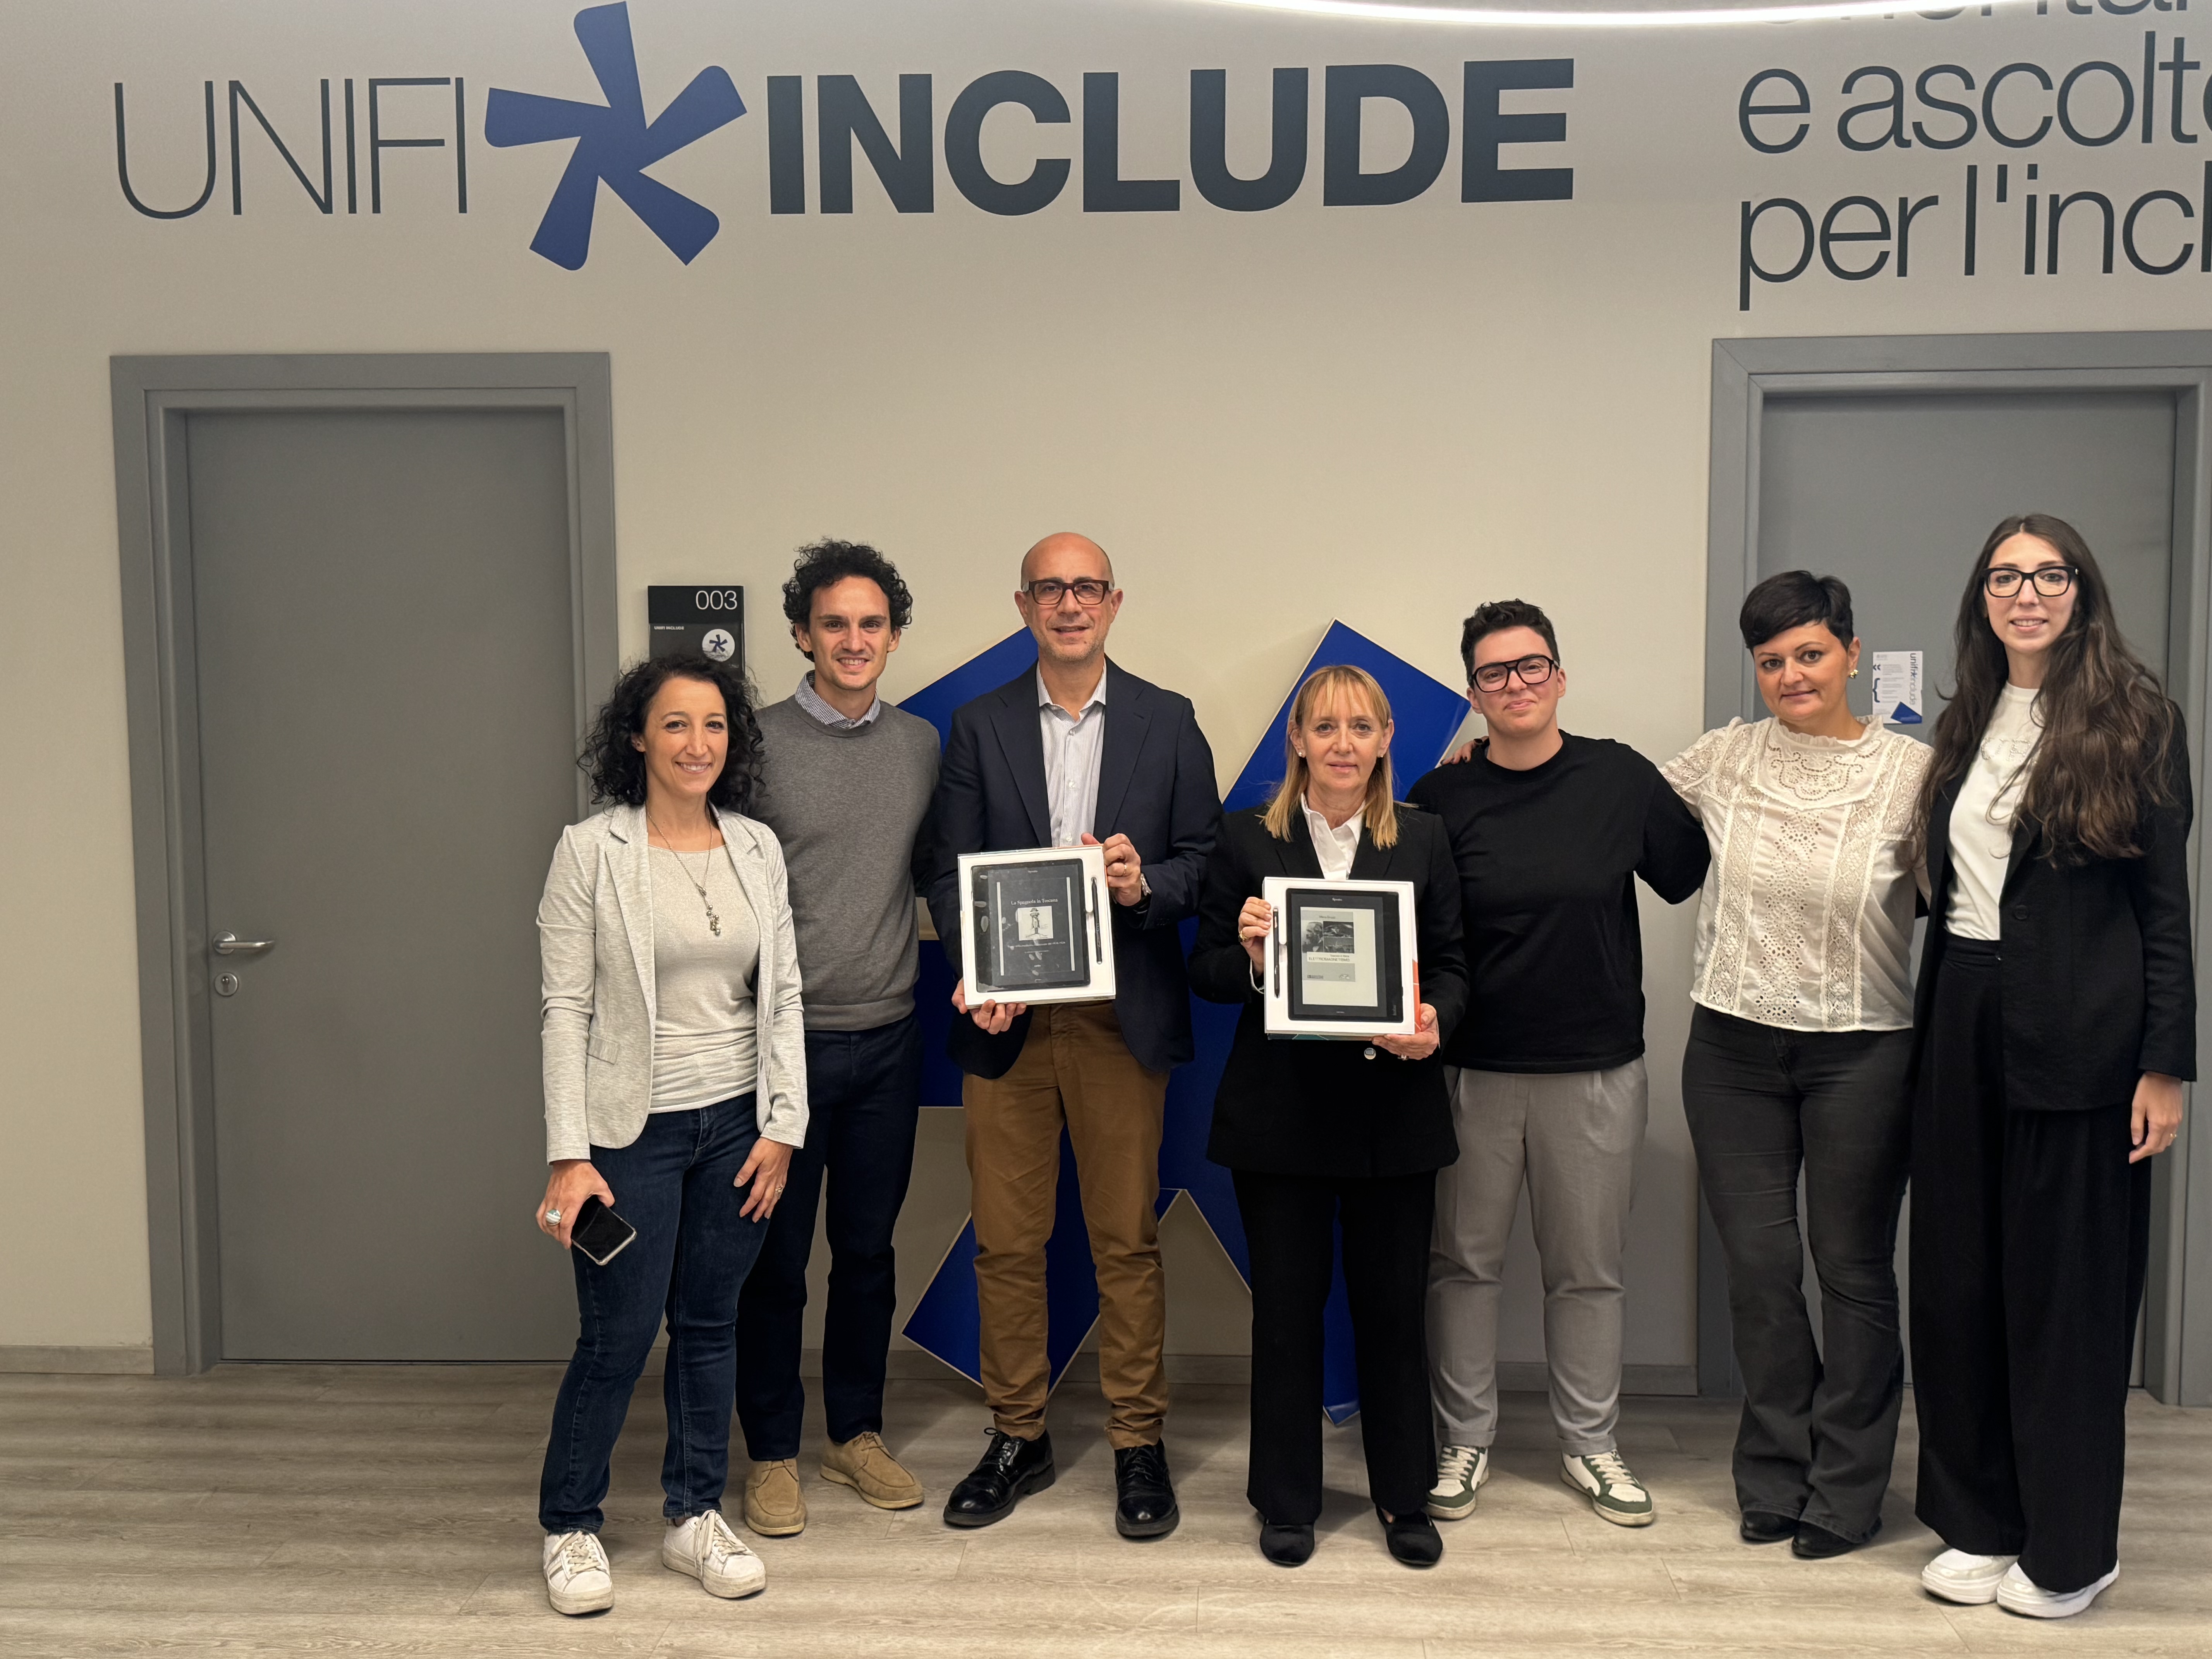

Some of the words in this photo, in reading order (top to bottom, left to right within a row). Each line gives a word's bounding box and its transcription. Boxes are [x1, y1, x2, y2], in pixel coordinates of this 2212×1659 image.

[115, 77, 467, 219] UNIFI
[767, 58, 1574, 216] INCLUDE
[1739, 69, 1810, 153] e
[1838, 31, 2212, 153] ascolt
[1740, 195, 1938, 311] per
[696, 591, 737, 610] 003
